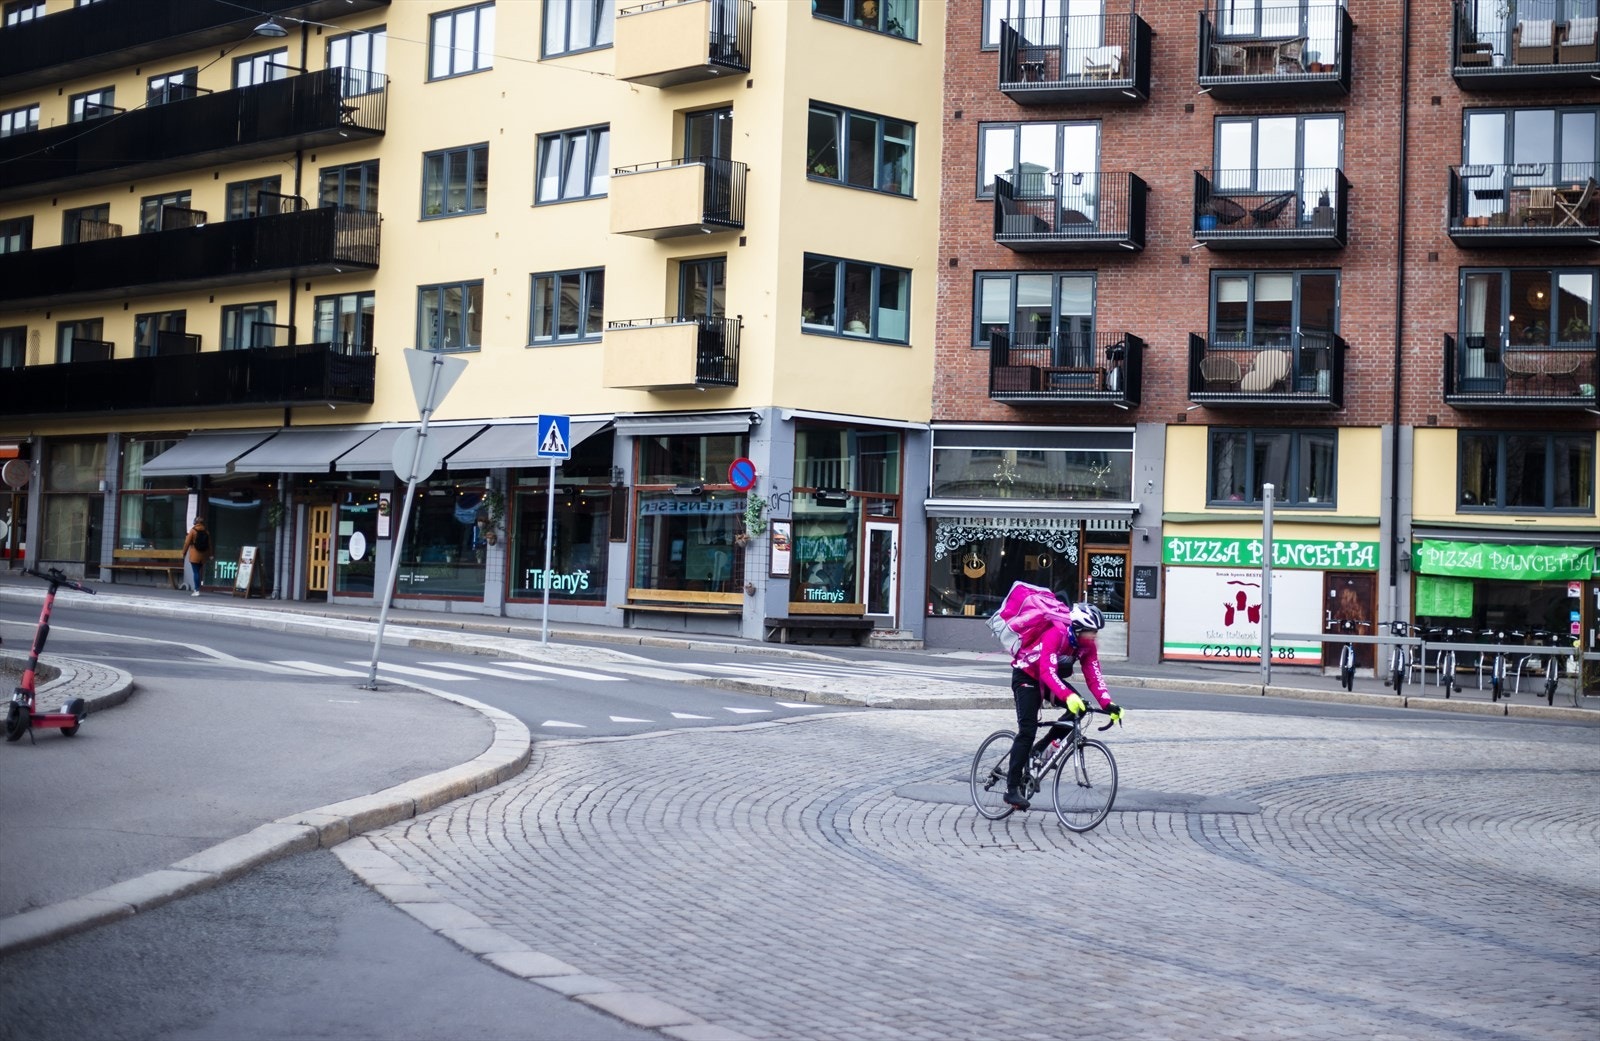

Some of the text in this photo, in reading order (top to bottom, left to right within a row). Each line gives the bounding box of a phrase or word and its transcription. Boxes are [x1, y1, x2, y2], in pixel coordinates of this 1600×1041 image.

[1168, 538, 1241, 564] PIZZA
[1427, 547, 1483, 569] PIZZA
[1489, 551, 1591, 573] PANCETTA
[1091, 565, 1123, 578] Skatt
[530, 569, 589, 595] Tiffany's
[807, 588, 845, 603] Tiffany's
[1214, 645, 1231, 658] 23
[1236, 646, 1252, 659] 00
[1279, 647, 1295, 660] 88
